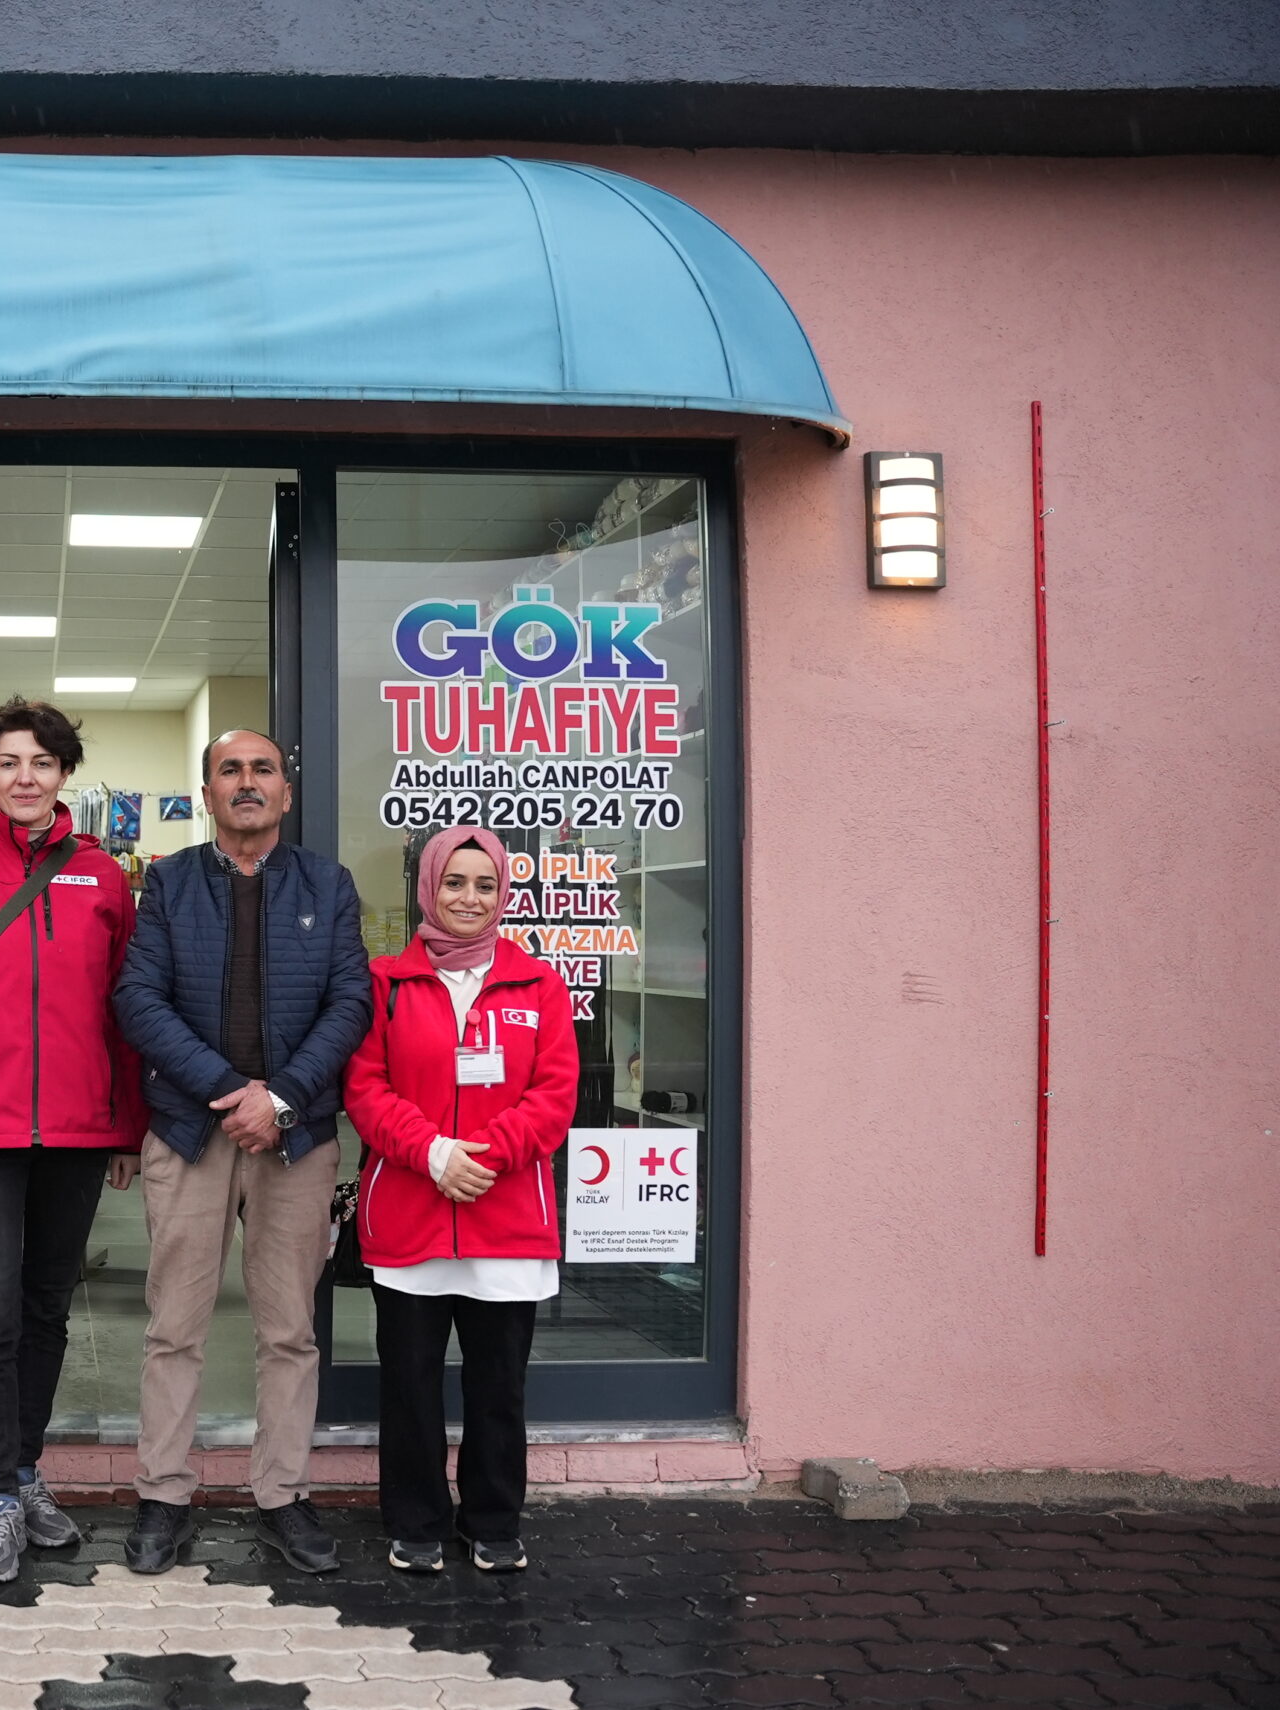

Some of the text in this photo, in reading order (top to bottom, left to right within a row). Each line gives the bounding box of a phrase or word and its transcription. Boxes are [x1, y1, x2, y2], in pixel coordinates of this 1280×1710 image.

[394, 586, 666, 679] GÖK
[394, 763, 670, 790] Abdullah CANPOLAT
[383, 796, 681, 829] 0542 205 24 70
[537, 927, 636, 952] YAZMA
[575, 1195, 610, 1204] KIZILAY
[638, 1183, 690, 1202] IFRC
